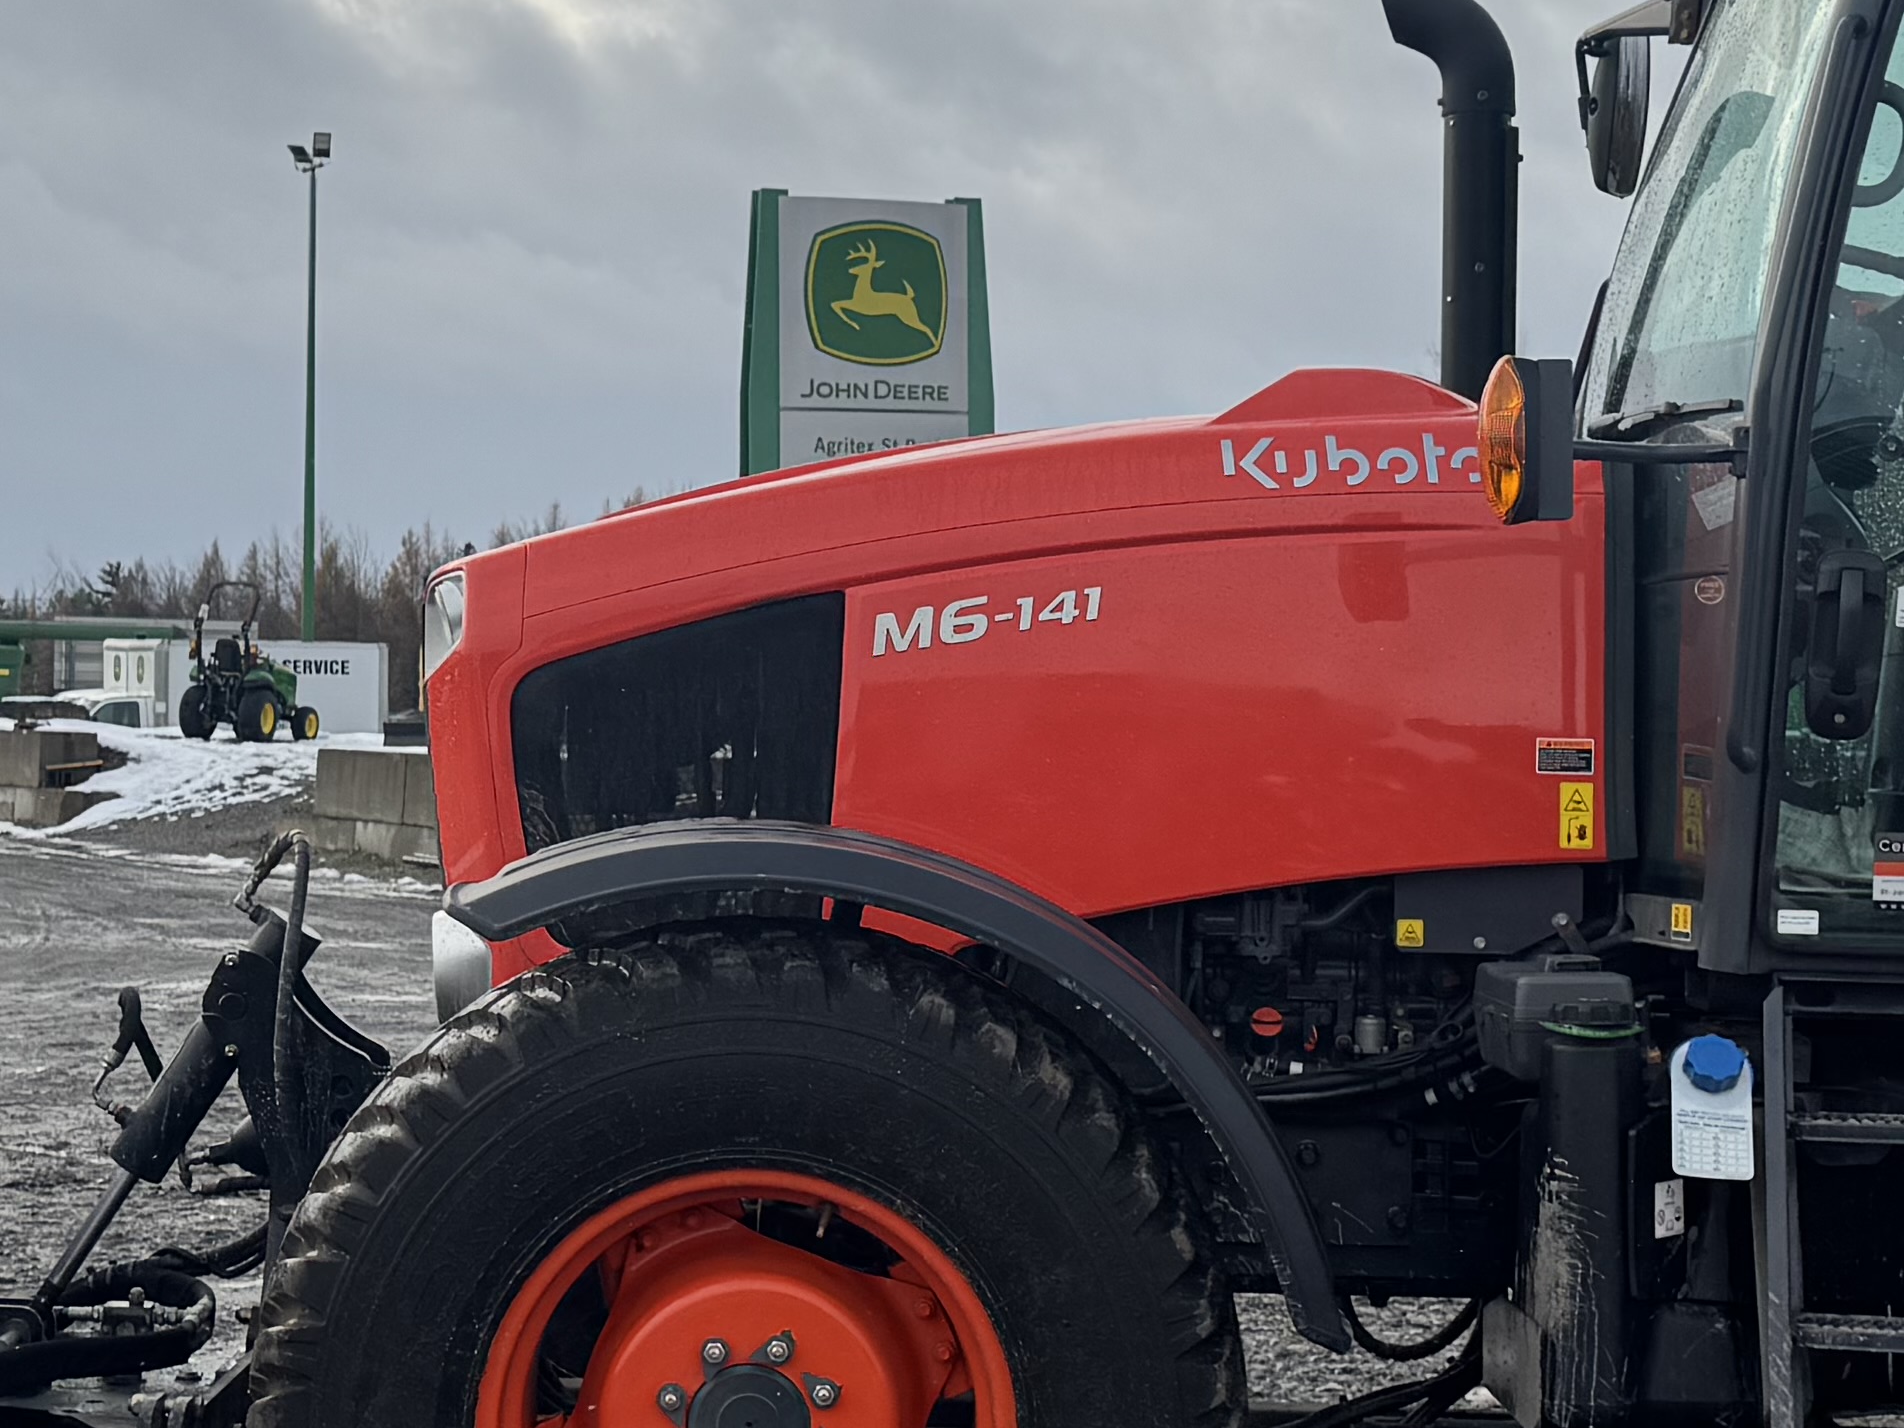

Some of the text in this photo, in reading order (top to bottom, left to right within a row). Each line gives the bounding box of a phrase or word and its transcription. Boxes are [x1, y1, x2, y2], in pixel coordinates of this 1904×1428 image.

[800, 378, 949, 402] JOHN DEERE
[814, 437, 874, 457] Agritex
[872, 586, 1102, 657] M6-141
